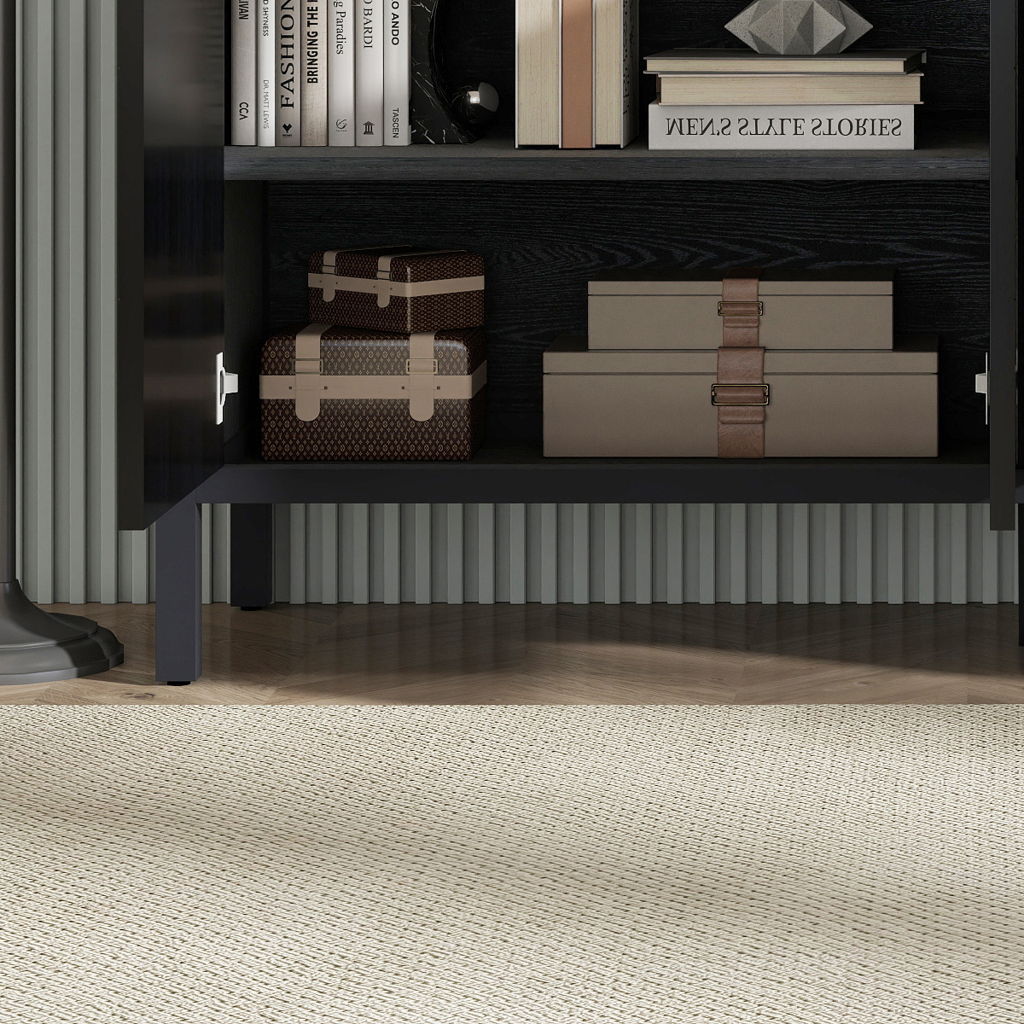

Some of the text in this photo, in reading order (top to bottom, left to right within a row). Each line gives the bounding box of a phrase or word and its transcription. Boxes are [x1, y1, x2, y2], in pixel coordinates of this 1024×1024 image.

[262, 7, 270, 37] SHYNESS
[306, 6, 318, 28] THE
[335, 11, 347, 55] Paradies
[363, 8, 373, 48] BARDI
[391, 12, 400, 46] ANDO
[306, 31, 318, 84] BRINGING
[238, 101, 249, 121] CCA
[262, 91, 270, 108] MATT
